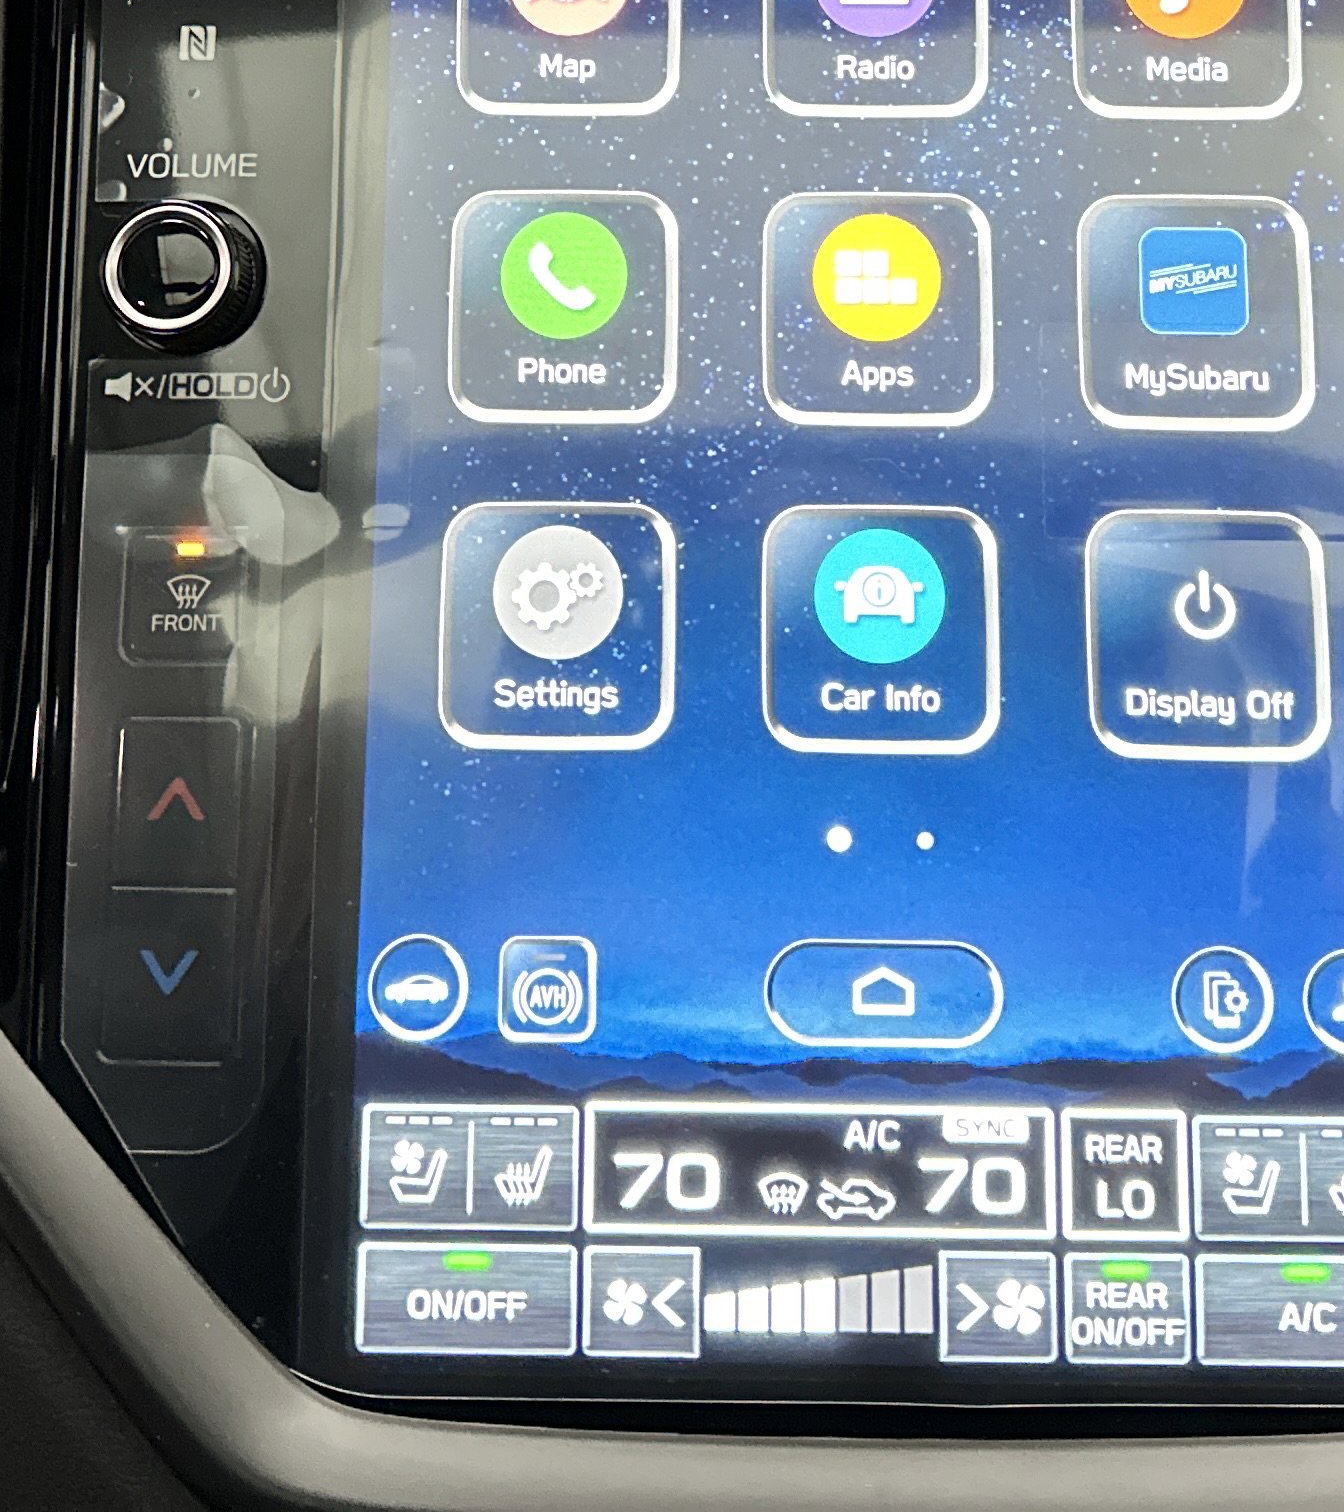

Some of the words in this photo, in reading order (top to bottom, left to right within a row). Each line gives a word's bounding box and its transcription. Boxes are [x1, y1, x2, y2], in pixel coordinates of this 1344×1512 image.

[539, 54, 596, 82] Map
[836, 55, 915, 81] Radio
[1145, 56, 1228, 83] Media
[127, 152, 257, 179] VOLUME
[517, 357, 607, 385] Phone
[842, 361, 914, 390] Apps
[1125, 362, 1270, 396] MySubaru
[171, 375, 255, 397] HOLD
[152, 614, 221, 632] FRONT
[494, 679, 619, 714] Settings
[821, 683, 876, 711] Car
[885, 683, 941, 711] Info
[1125, 687, 1235, 723] Display
[1246, 689, 1294, 719] Off
[530, 984, 567, 1009] AVH
[844, 1119, 901, 1151] A/C
[956, 1118, 1017, 1138] SYNC
[1085, 1134, 1162, 1163] REAR
[613, 1152, 721, 1211] 70
[918, 1157, 1026, 1215] 70
[1096, 1179, 1156, 1219] LO
[406, 1290, 528, 1321] ON/OFF
[1086, 1281, 1169, 1310] REAR
[1071, 1316, 1186, 1345] ON/OFF
[1278, 1302, 1337, 1333] A/C
